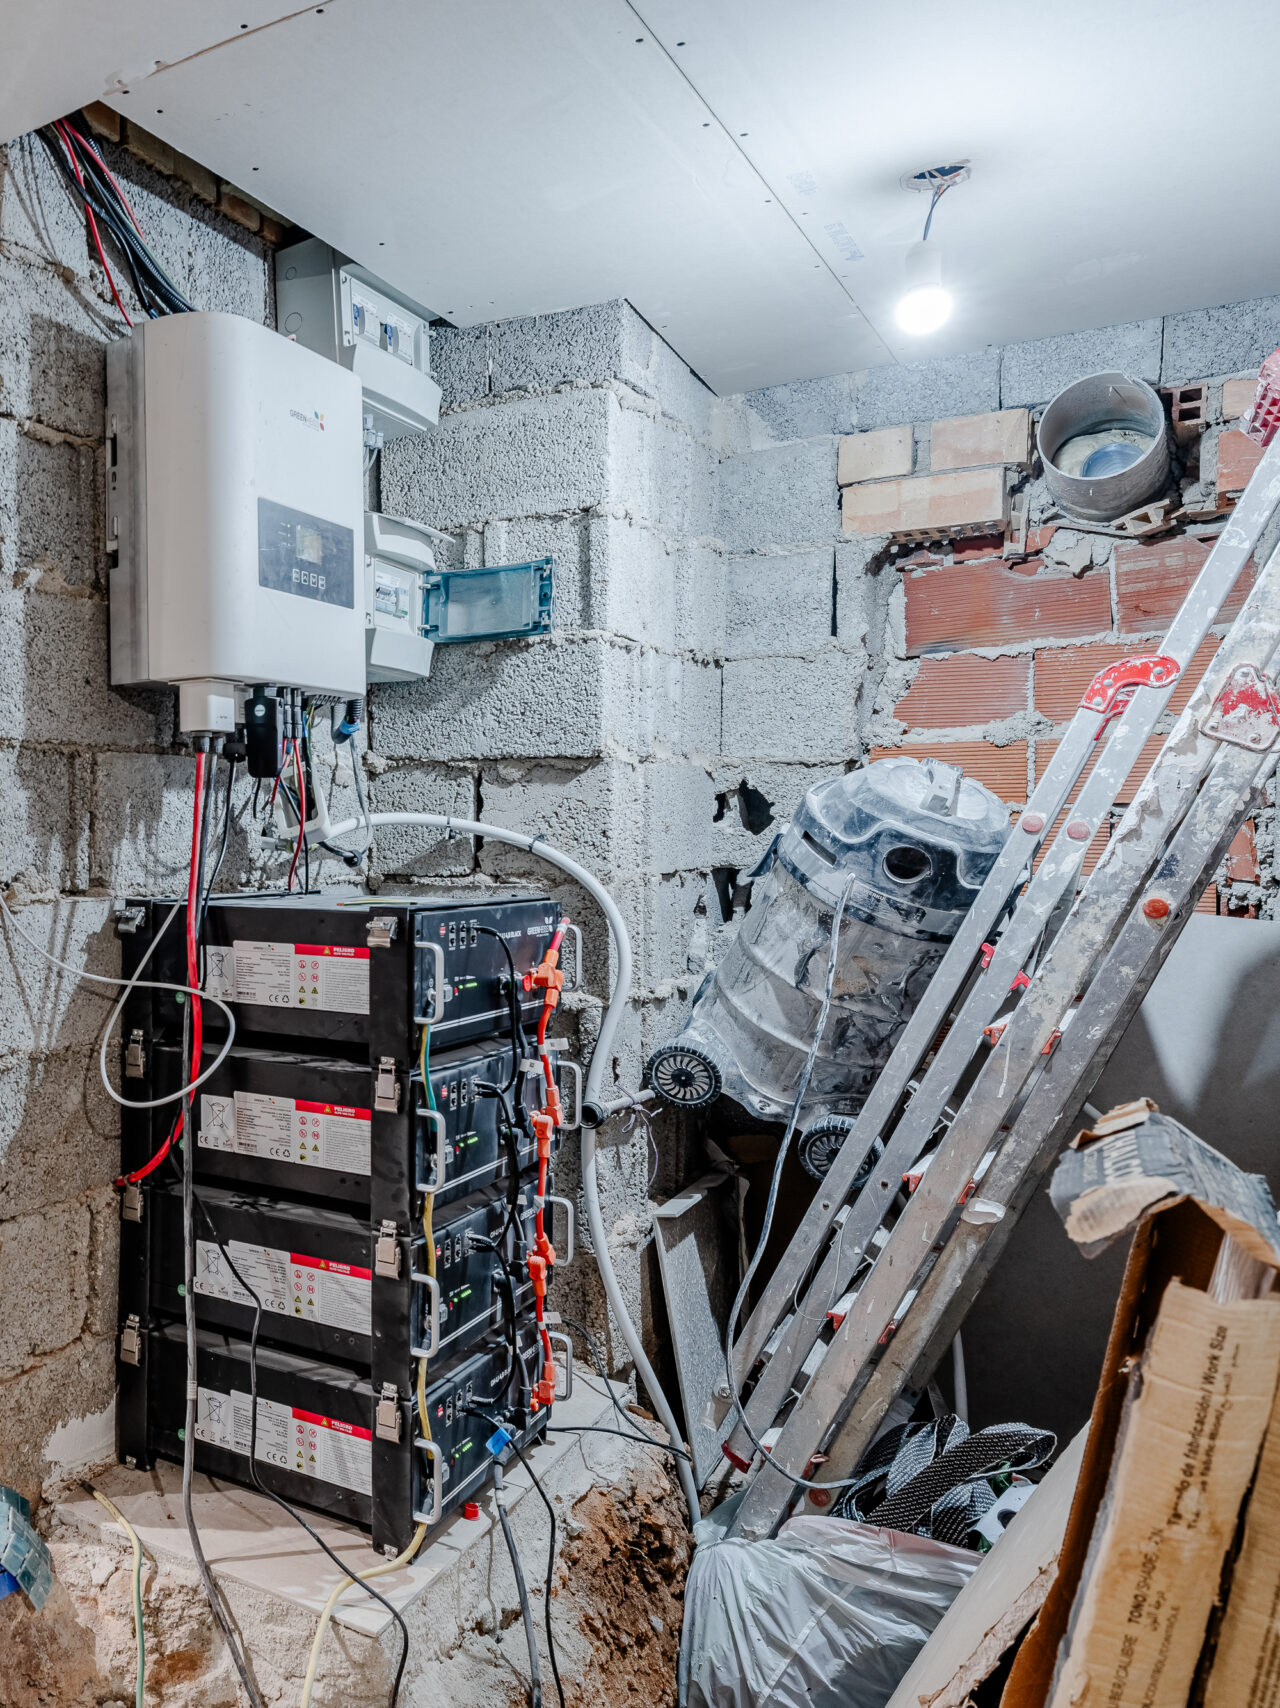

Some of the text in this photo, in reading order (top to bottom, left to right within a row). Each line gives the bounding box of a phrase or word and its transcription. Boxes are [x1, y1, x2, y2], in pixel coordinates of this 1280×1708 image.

[329, 1261, 351, 1271] PELIGRO
[1209, 1325, 1228, 1352] Size
[1202, 1354, 1219, 1386] Work
[331, 1420, 353, 1431] PELIGRO
[1180, 1461, 1195, 1478] de
